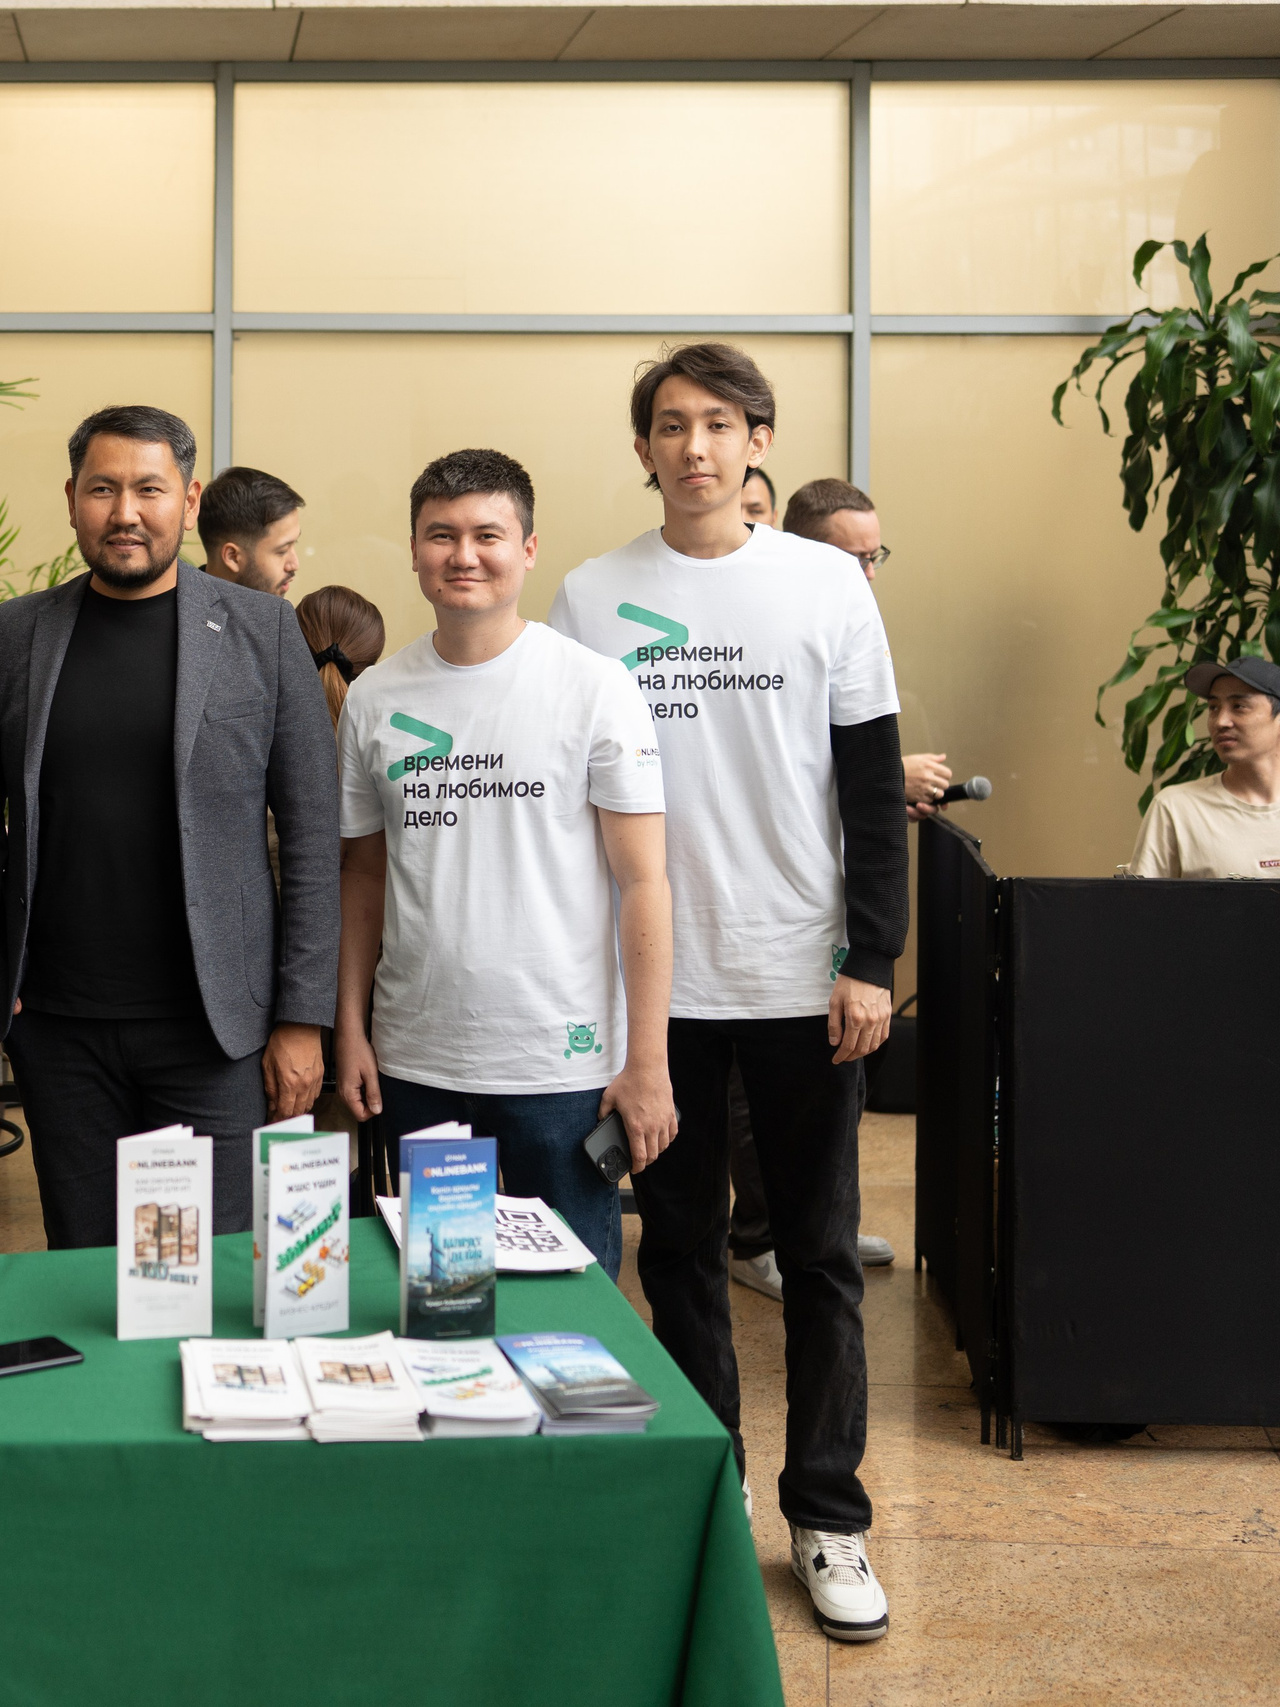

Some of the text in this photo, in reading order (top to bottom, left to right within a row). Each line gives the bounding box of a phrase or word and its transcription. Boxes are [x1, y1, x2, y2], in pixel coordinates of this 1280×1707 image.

[636, 645, 743, 668] времени
[638, 669, 785, 691] на любимое
[648, 702, 699, 721] ело
[403, 752, 504, 777] времени
[403, 778, 545, 799] на любимое
[403, 810, 458, 829] дело
[128, 1158, 198, 1171] ONLINEBANK
[282, 1157, 340, 1174] ONLINEBANK
[423, 1161, 488, 1179] ONLINEBANK
